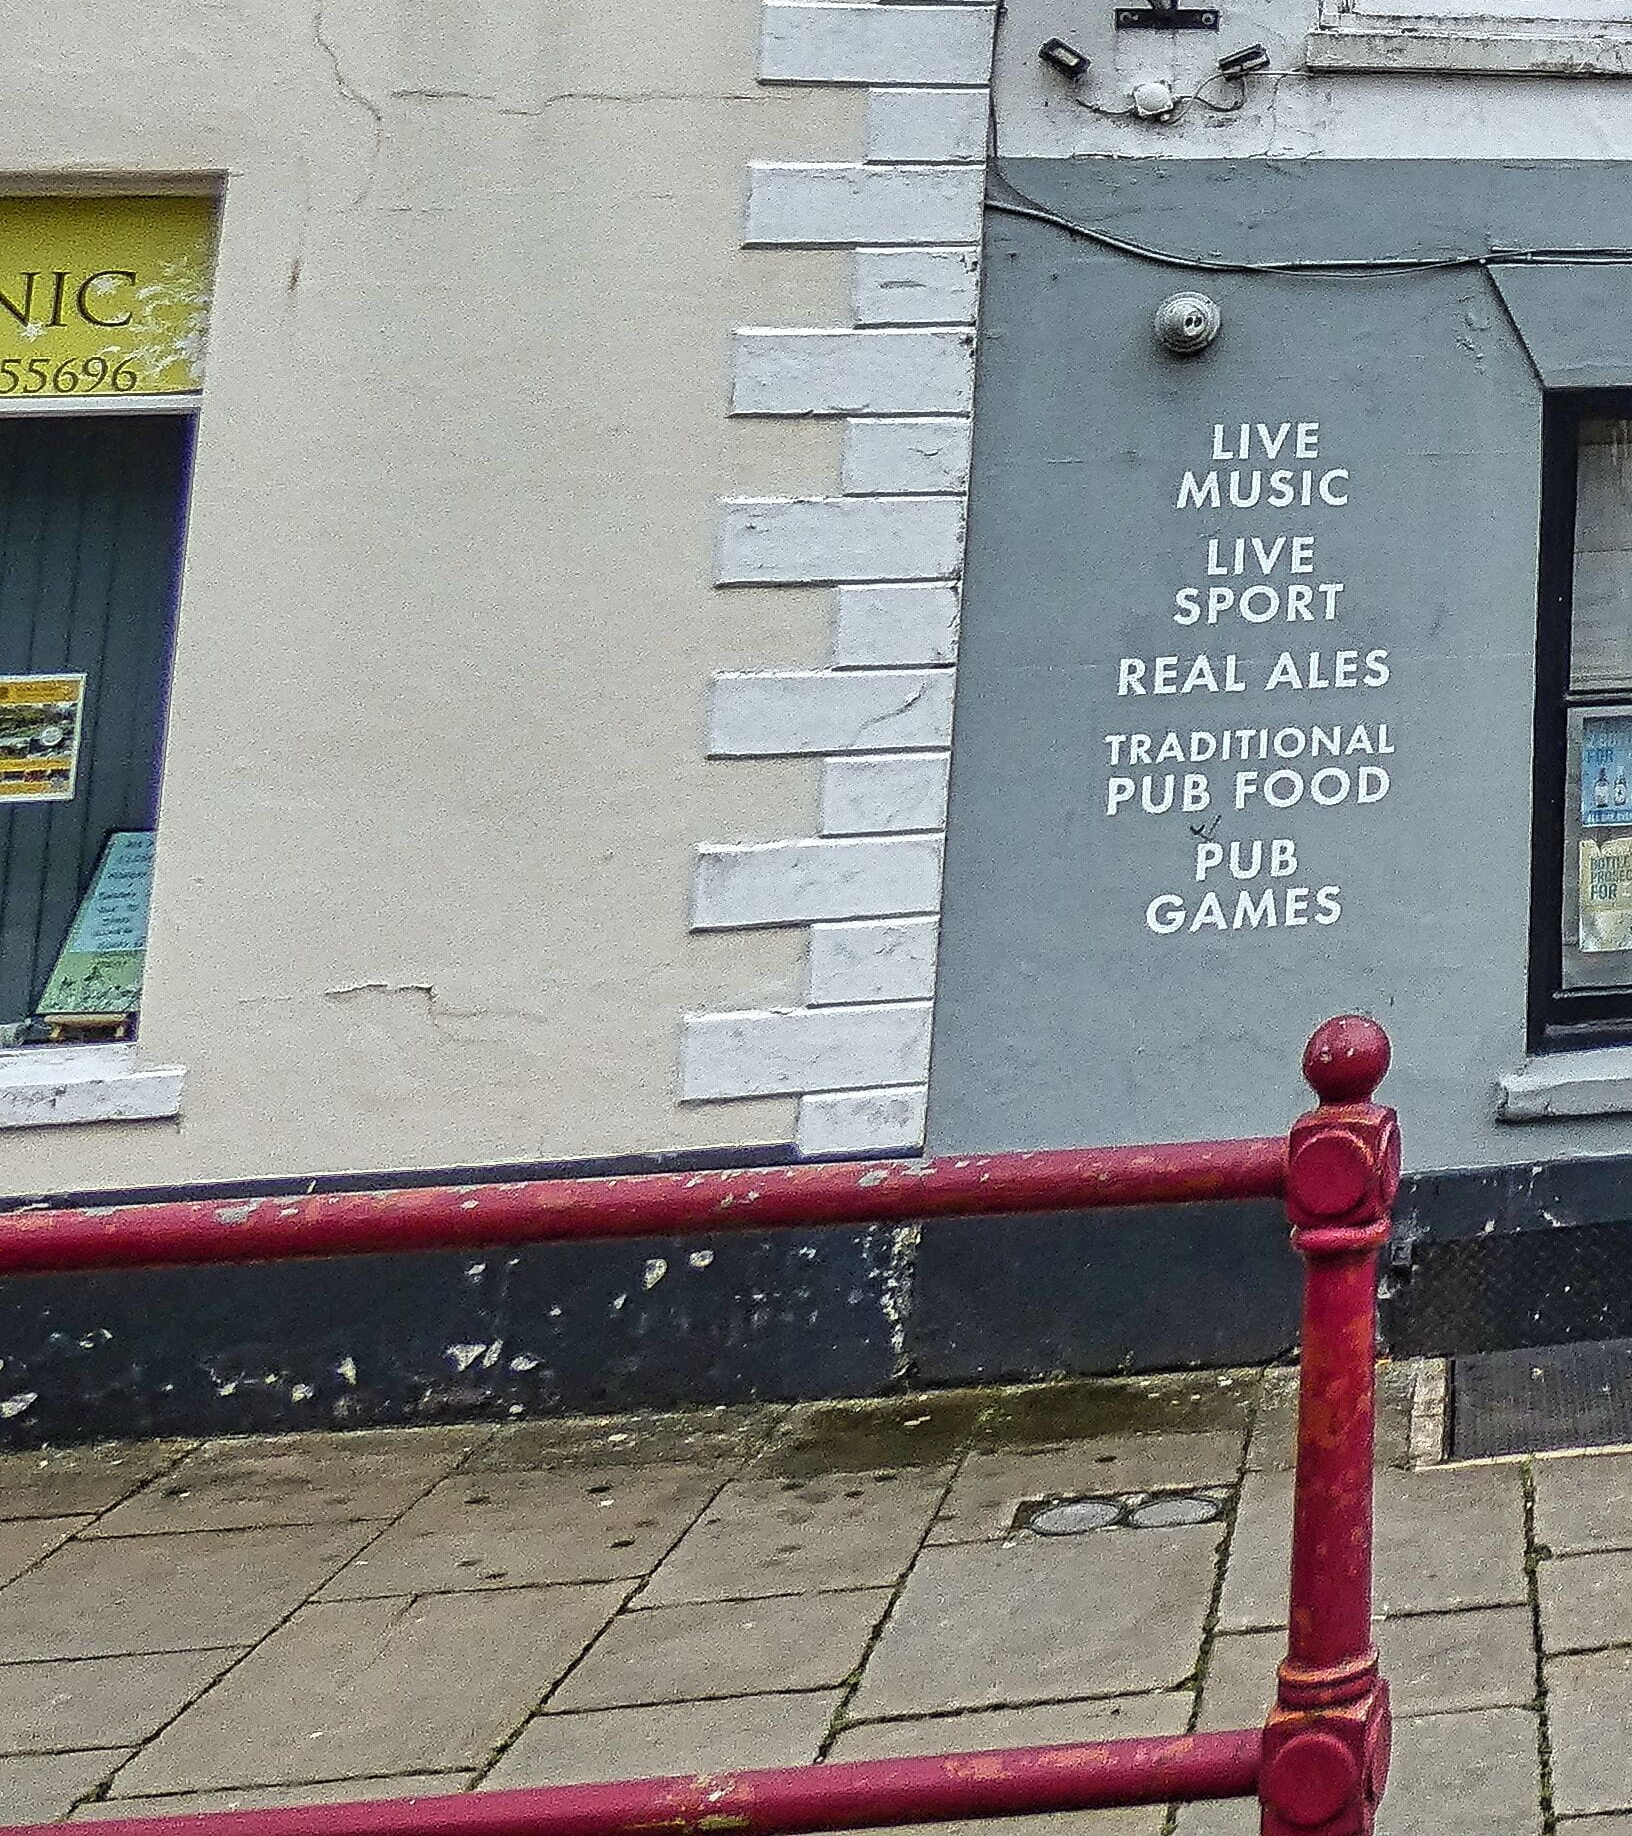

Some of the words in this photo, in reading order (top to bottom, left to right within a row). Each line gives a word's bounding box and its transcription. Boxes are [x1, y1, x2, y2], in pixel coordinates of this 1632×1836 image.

[1211, 421, 1320, 461] LIVE
[1176, 468, 1350, 509] MUSIC
[1207, 535, 1316, 577] LIVE
[1172, 583, 1344, 626] SPORT
[1117, 653, 1246, 697] REAL
[1264, 648, 1392, 690] ALES
[1104, 723, 1395, 765] TRADITIONAL
[1105, 771, 1212, 816] PUB
[1234, 765, 1392, 811] FOOD
[1195, 839, 1299, 882] PUB
[1145, 884, 1343, 934] GAMES
[1590, 883, 1617, 901] FOR
